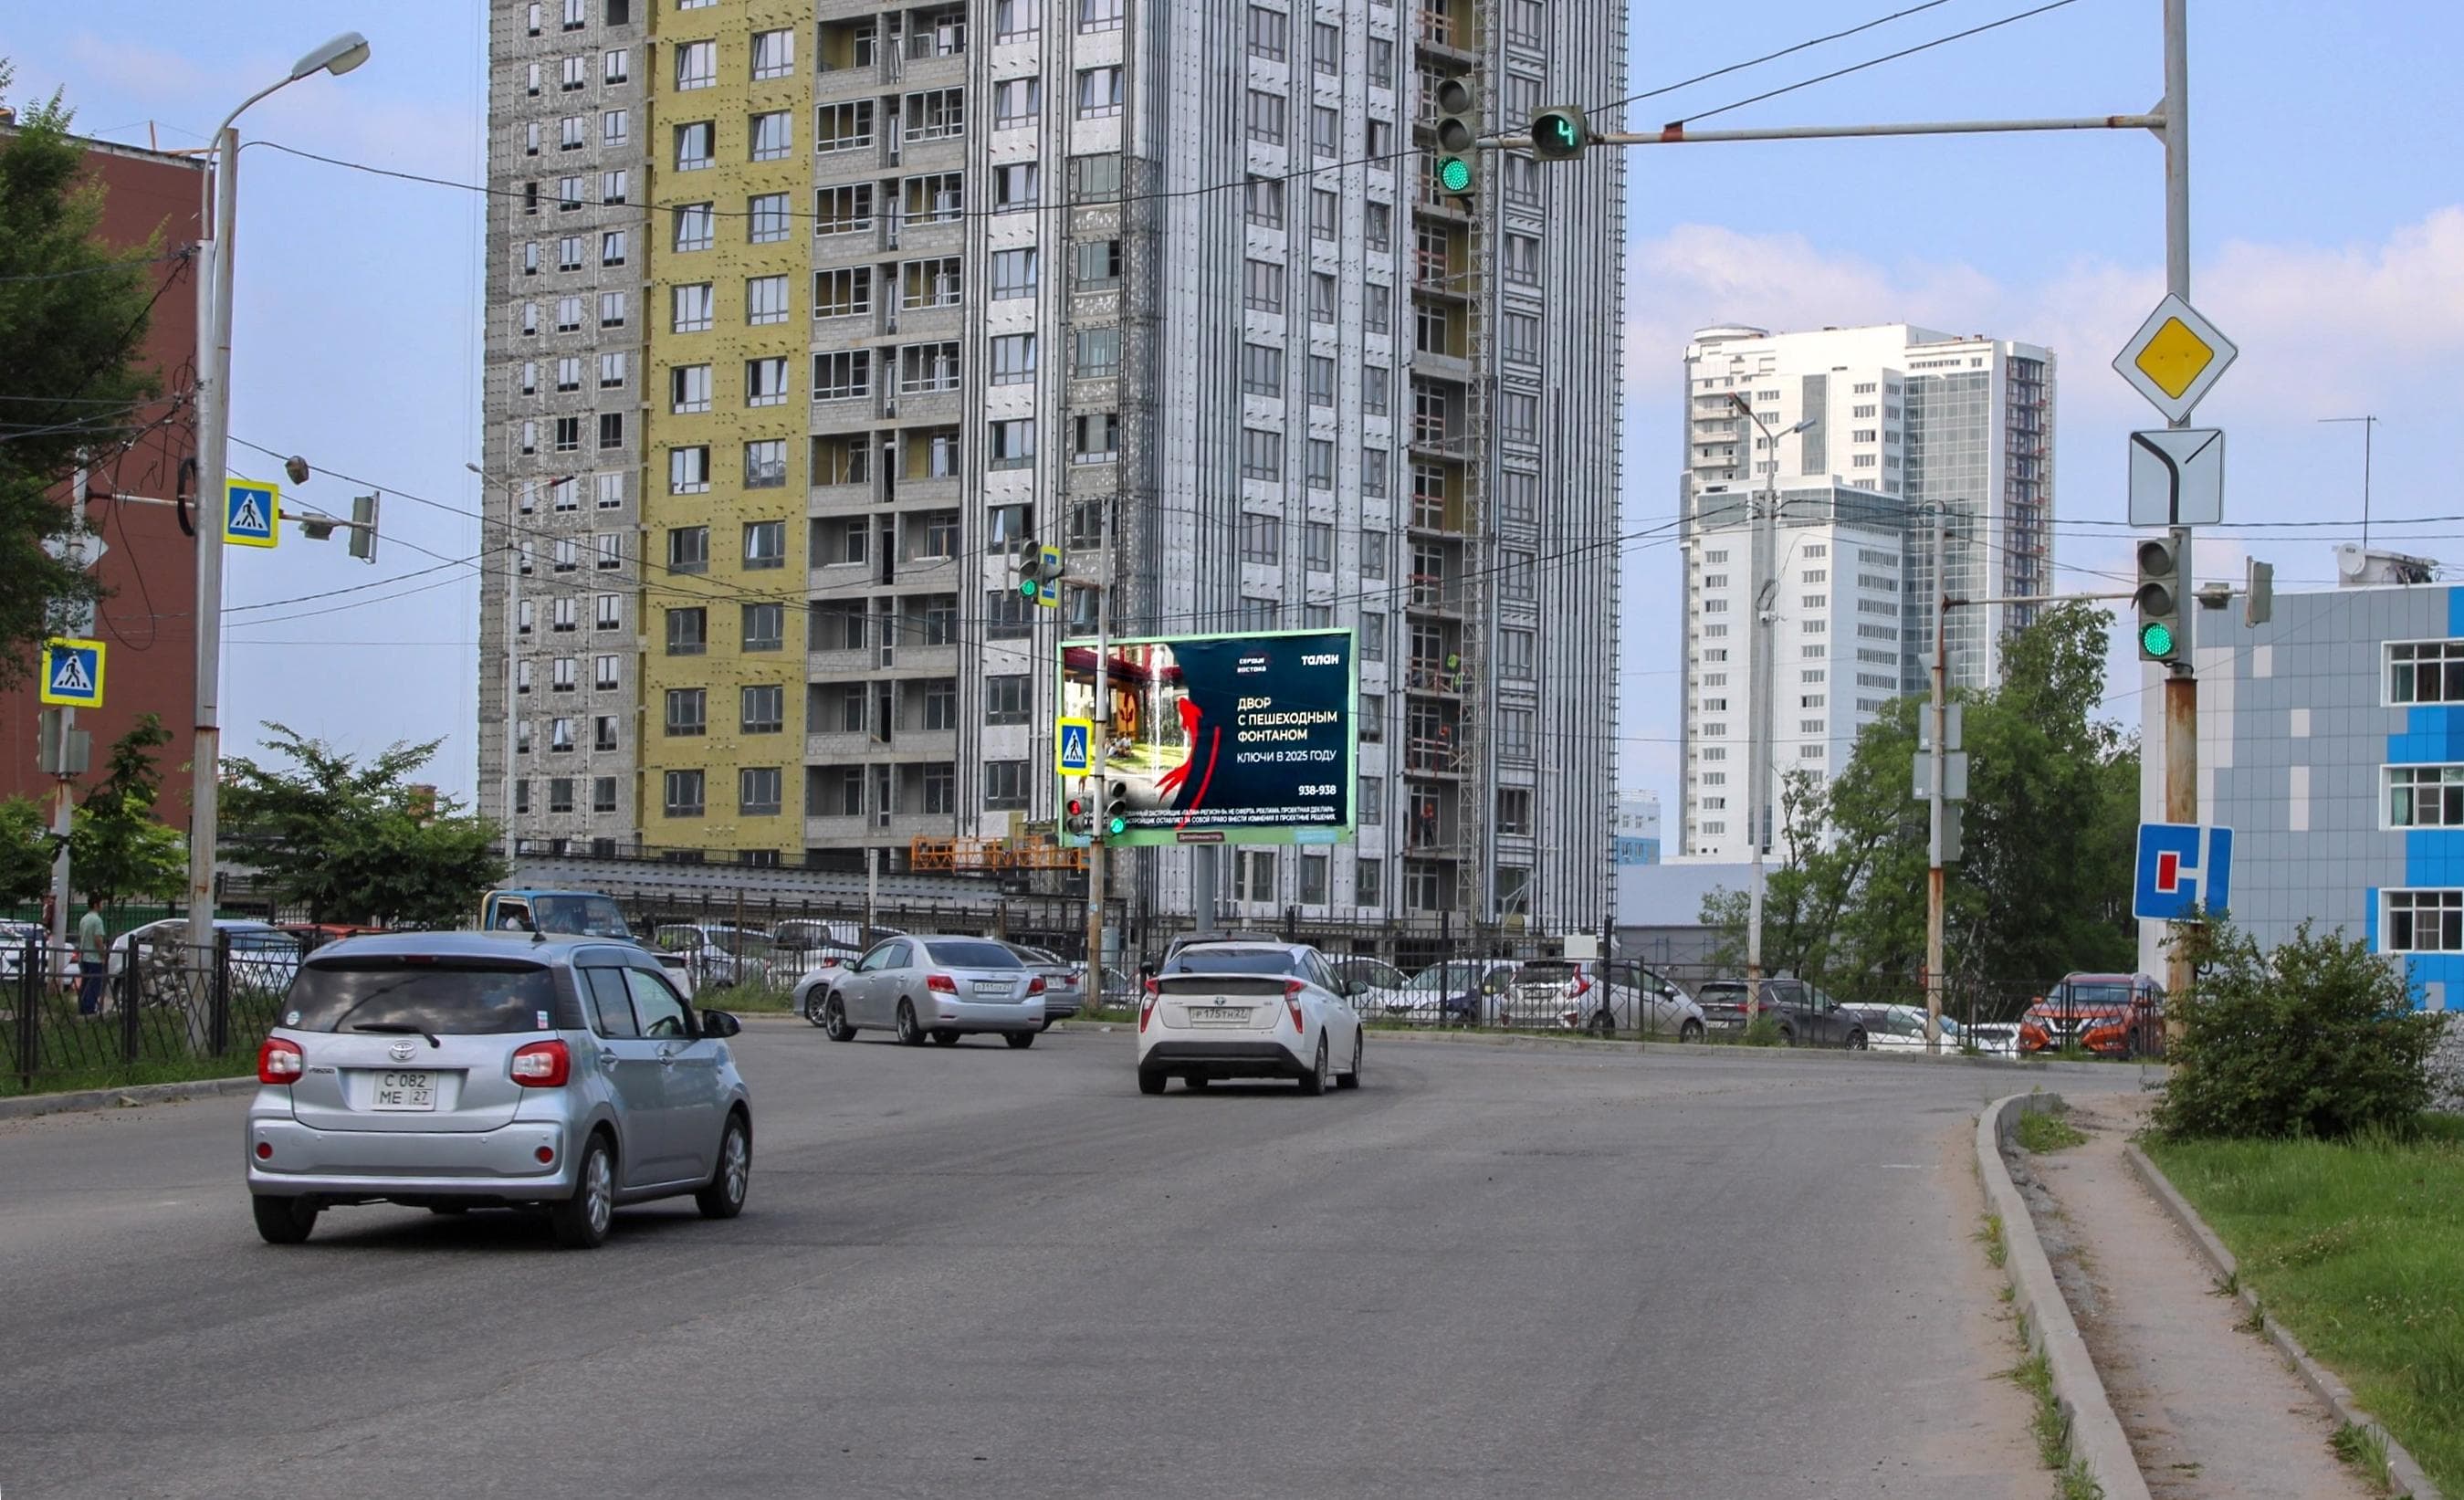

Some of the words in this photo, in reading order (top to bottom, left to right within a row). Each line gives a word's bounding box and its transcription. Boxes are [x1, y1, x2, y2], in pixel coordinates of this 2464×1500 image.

[1237, 698, 1272, 711] ДВОР
[1237, 715, 1246, 726] С
[1249, 711, 1338, 726] ПЕШЕХОДНЫМ
[1237, 729, 1307, 742] ФОНТАНОМ
[1237, 752, 1274, 763] КЛЮЧИ
[1276, 751, 1284, 761] В
[1284, 750, 1308, 761] 2025
[1309, 749, 1337, 762] ГОДУ
[1298, 785, 1337, 796] 938-938
[384, 1074, 394, 1087] С
[399, 1075, 425, 1087] 082
[379, 1091, 402, 1104] МЕ
[414, 1091, 428, 1102] 27
